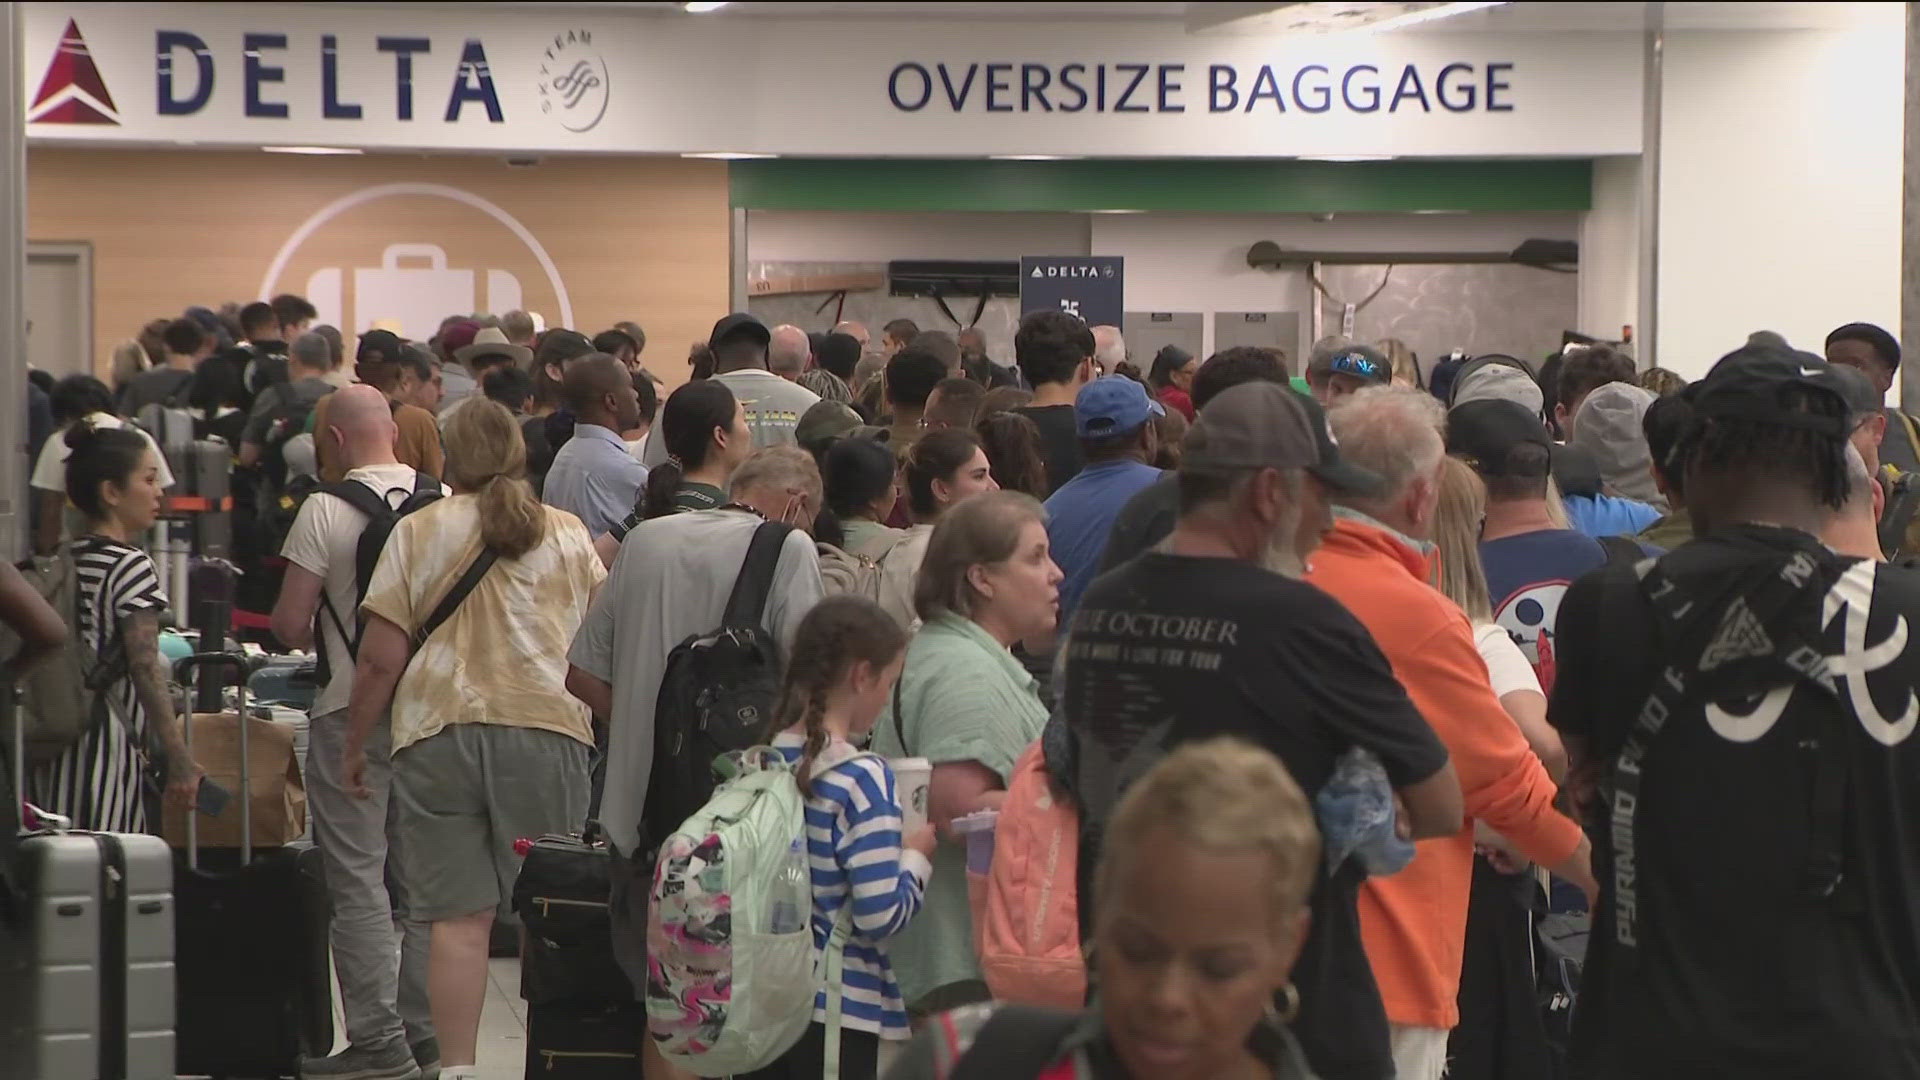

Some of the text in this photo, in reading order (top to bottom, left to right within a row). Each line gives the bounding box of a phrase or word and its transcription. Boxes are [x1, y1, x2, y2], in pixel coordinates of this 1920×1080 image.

[156, 38, 505, 122] DELTA
[888, 62, 1515, 113] OVERSIZE BAGGAGE
[1047, 266, 1098, 278] DELTA
[1108, 610, 1239, 646] OCTOBER
[1612, 789, 1637, 947] PYRAMID
